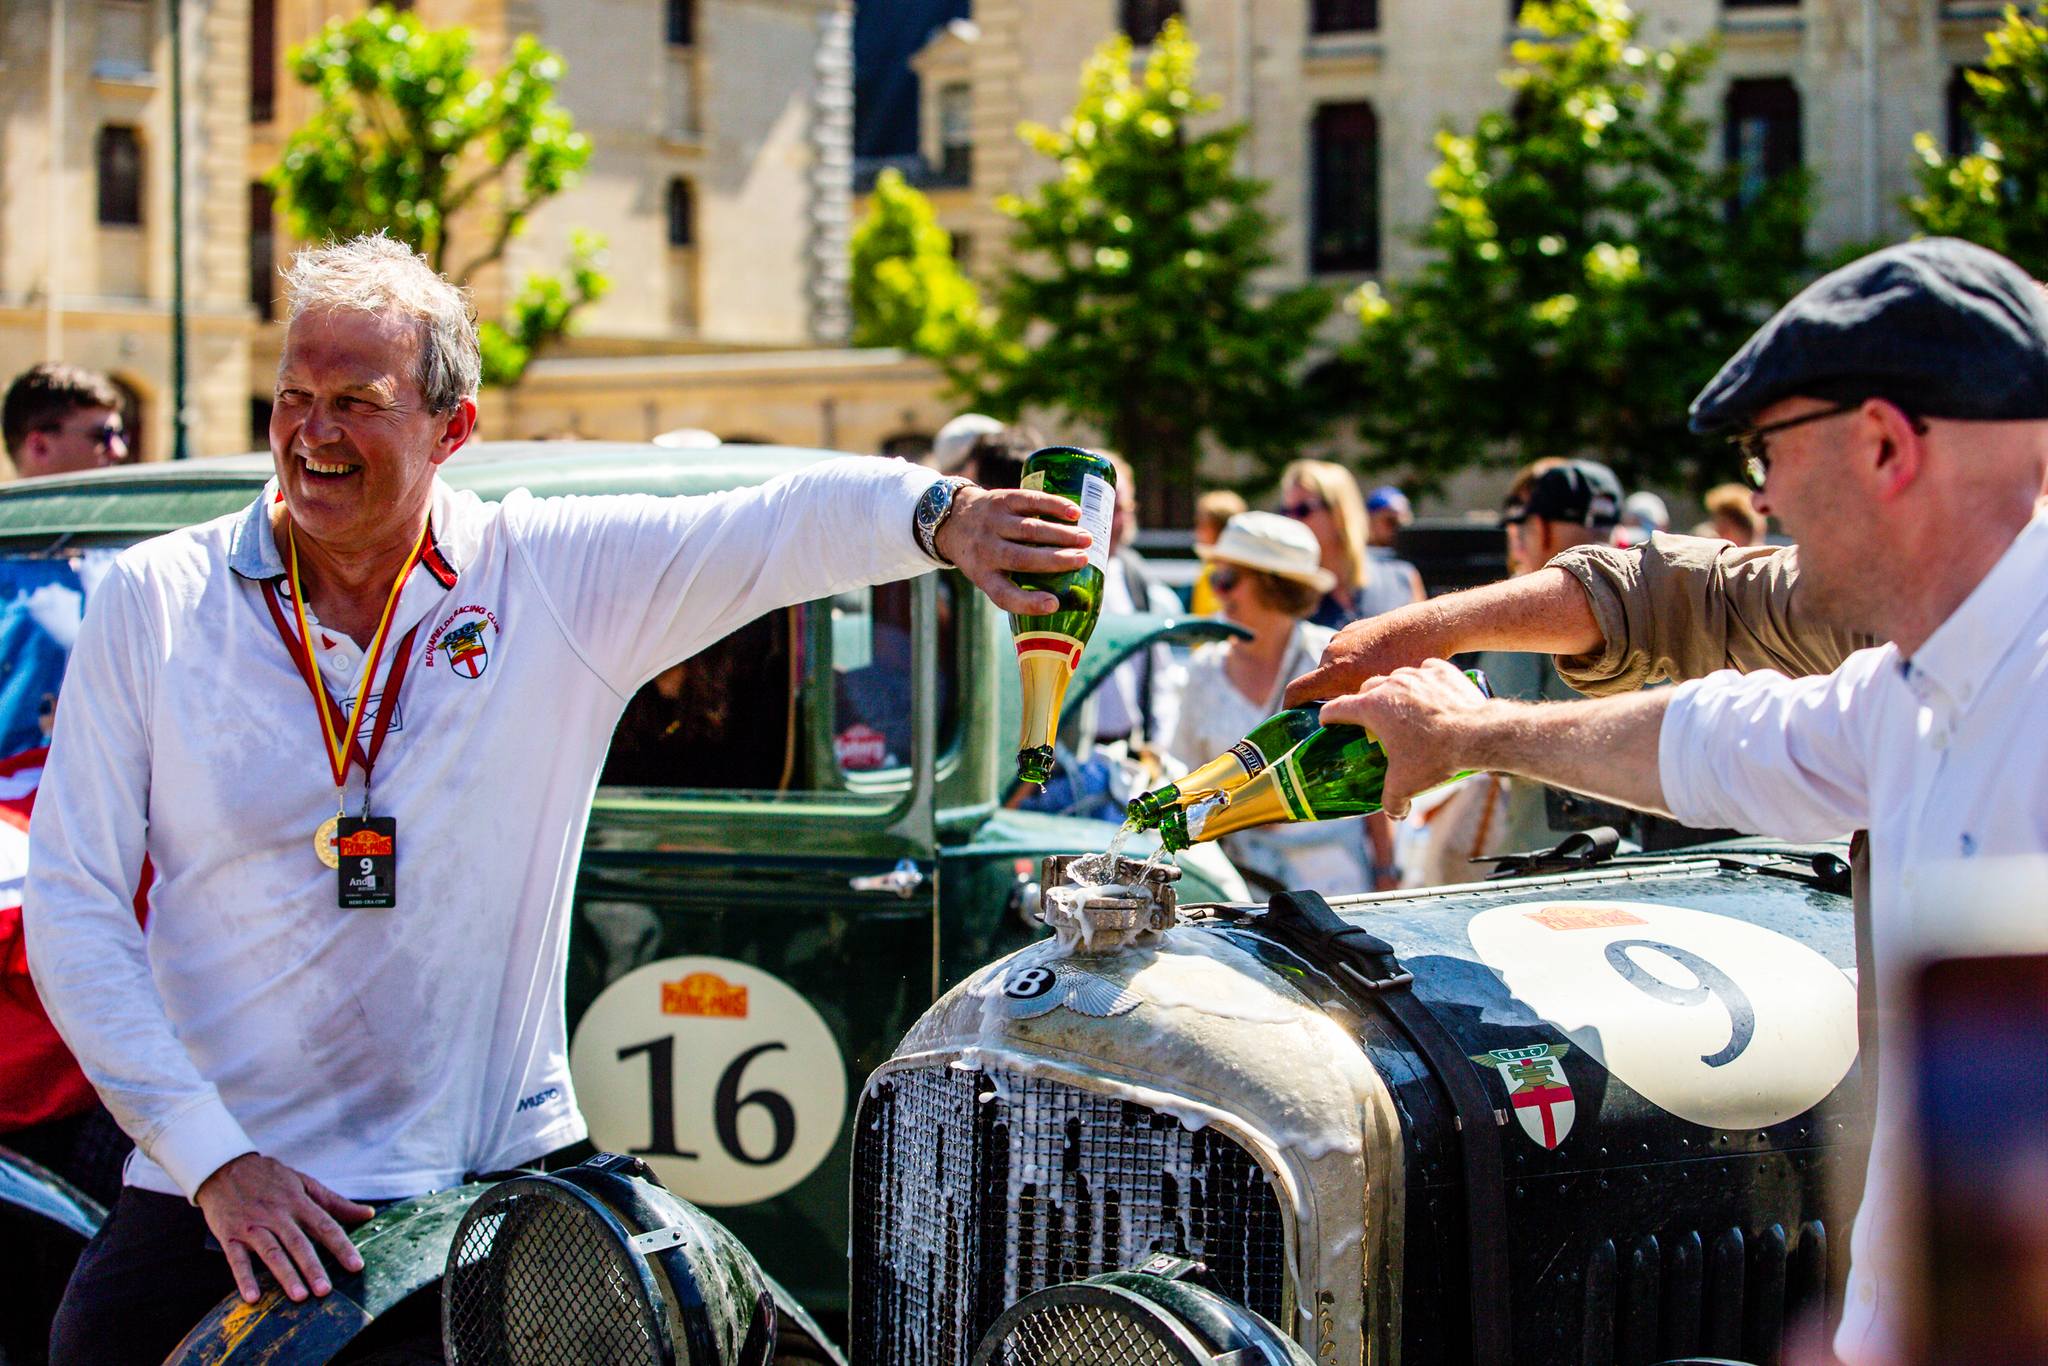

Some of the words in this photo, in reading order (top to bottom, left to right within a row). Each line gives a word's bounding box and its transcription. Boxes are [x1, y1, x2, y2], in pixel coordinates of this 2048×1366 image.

[453, 605, 487, 618] RACING
[359, 857, 373, 875] 9
[1604, 939, 1755, 1068] 9
[516, 1088, 560, 1112] MUSTO
[616, 1034, 797, 1167] 16
